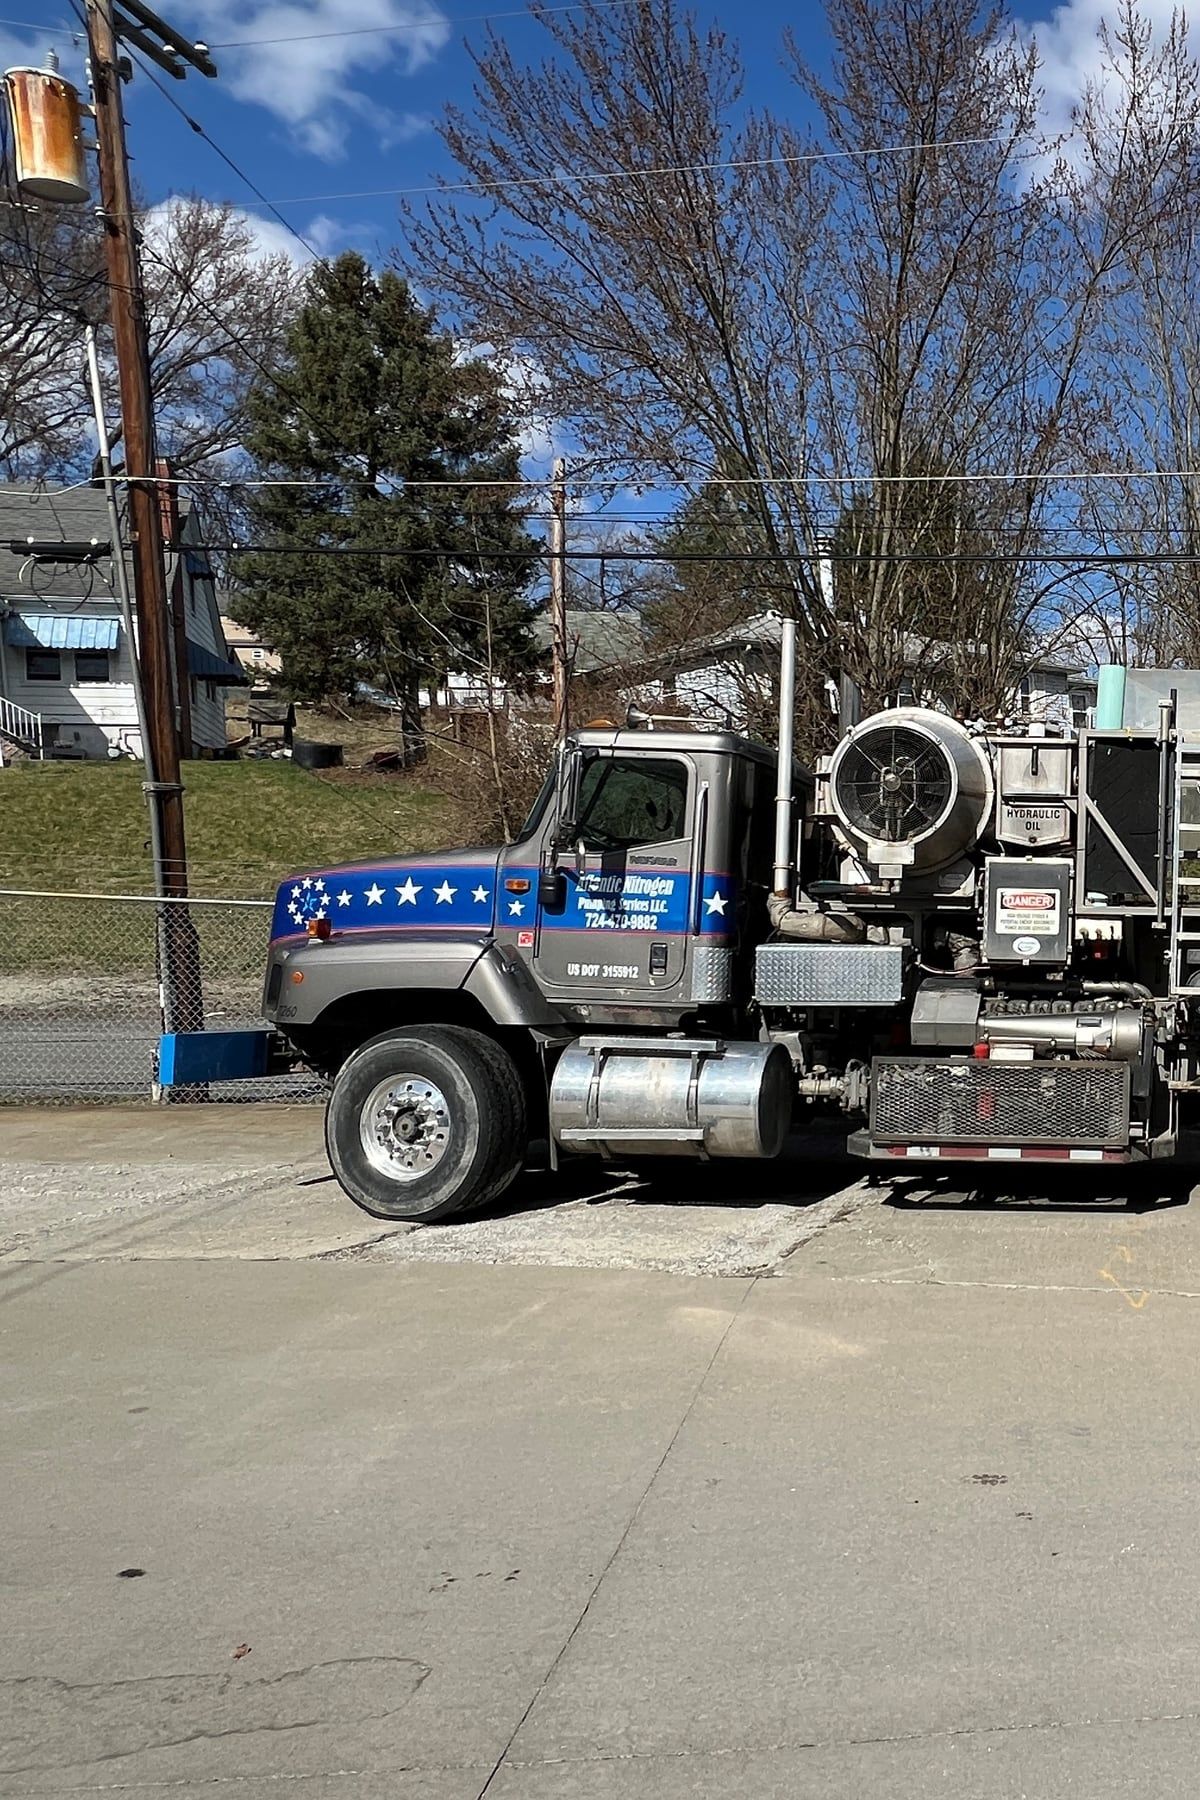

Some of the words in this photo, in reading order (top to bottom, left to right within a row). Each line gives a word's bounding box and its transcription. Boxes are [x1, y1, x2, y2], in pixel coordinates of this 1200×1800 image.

[1007, 809, 1060, 819] HYDRAULIC
[1025, 821, 1041, 831] OIL
[575, 874, 623, 893] Atlantic
[622, 875, 674, 896] Nitrogen
[618, 897, 649, 912] Services
[1008, 896, 1050, 907] DANGER
[585, 913, 657, 929] 724-470-9882
[567, 963, 581, 976] US
[581, 964, 601, 977] DOT
[602, 965, 639, 978] 3155912
